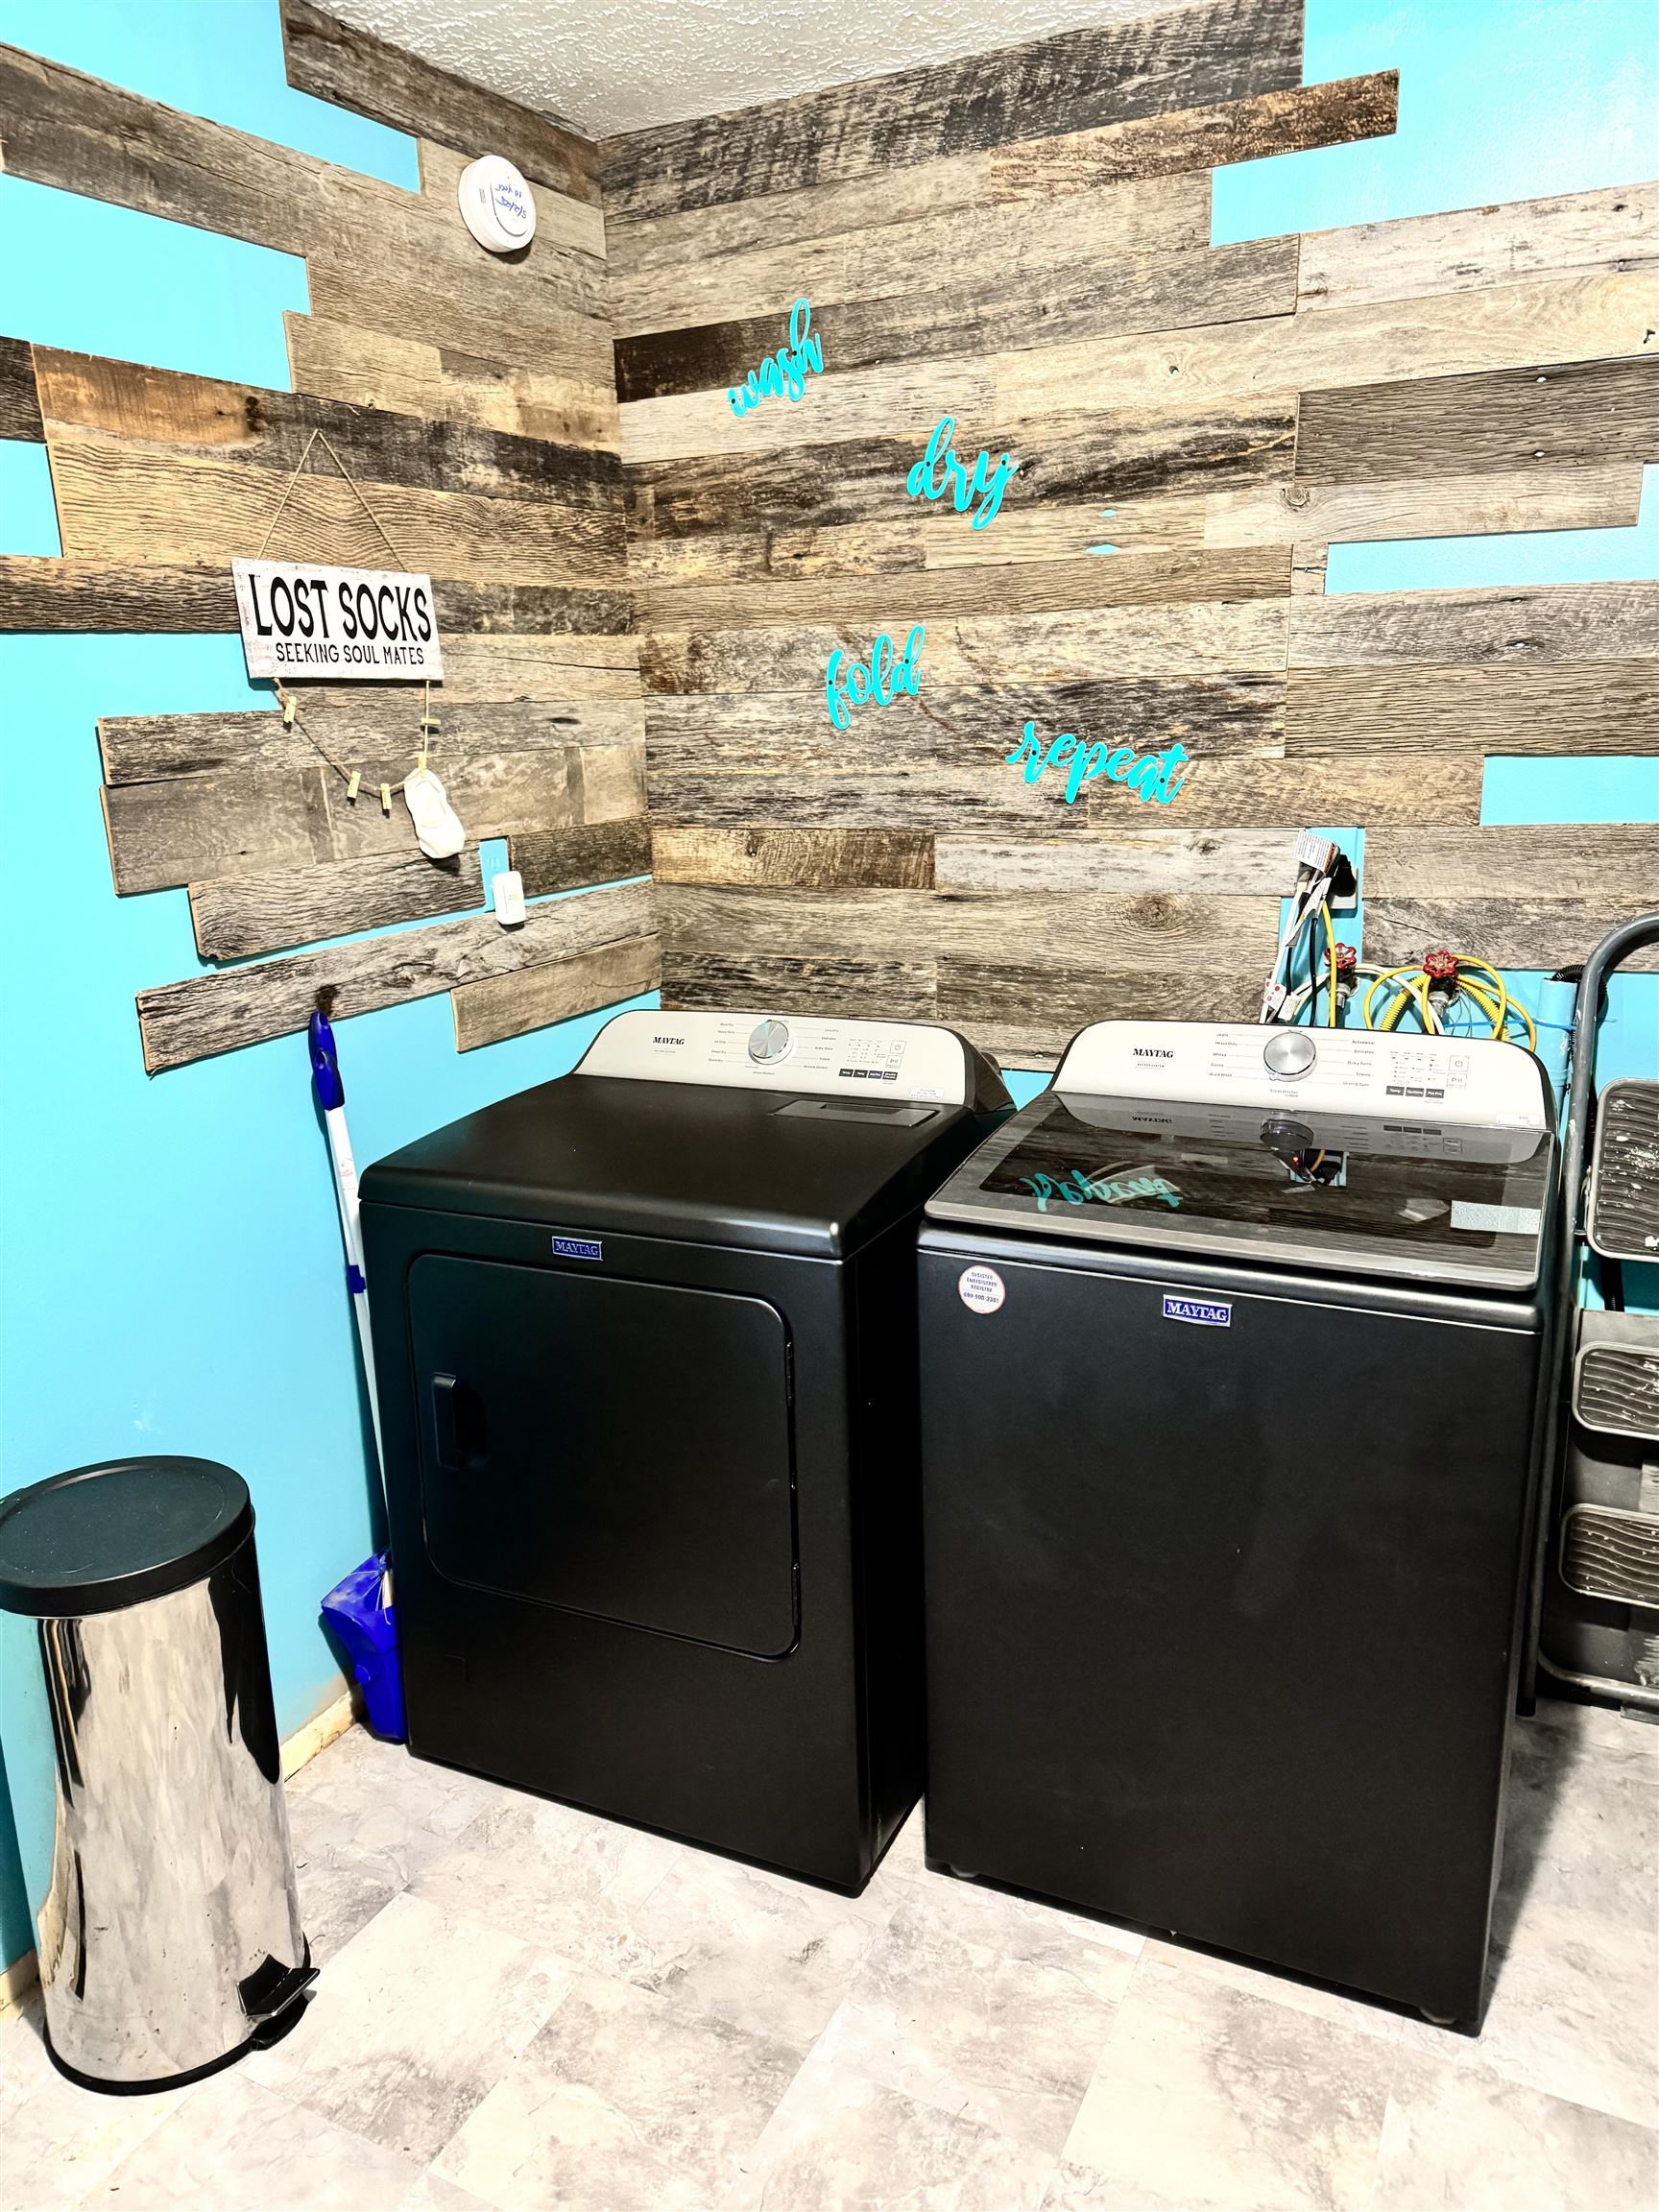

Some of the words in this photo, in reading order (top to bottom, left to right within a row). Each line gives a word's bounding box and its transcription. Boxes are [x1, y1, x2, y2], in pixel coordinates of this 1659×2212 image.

[727, 298, 823, 417] wash
[906, 417, 1019, 530] dry
[248, 573, 330, 638] LOST
[338, 582, 432, 642] SOCKS
[276, 642, 340, 663] SEEKING
[344, 644, 380, 664] SOUL
[383, 645, 425, 665] MATES
[826, 626, 926, 730] fold
[1005, 721, 1190, 804] repeat
[652, 1036, 685, 1046] MAYTAG
[1132, 1047, 1174, 1058] MAYTAG
[554, 1240, 599, 1256] MAYTAG
[1166, 1301, 1228, 1322] MAYTAG
